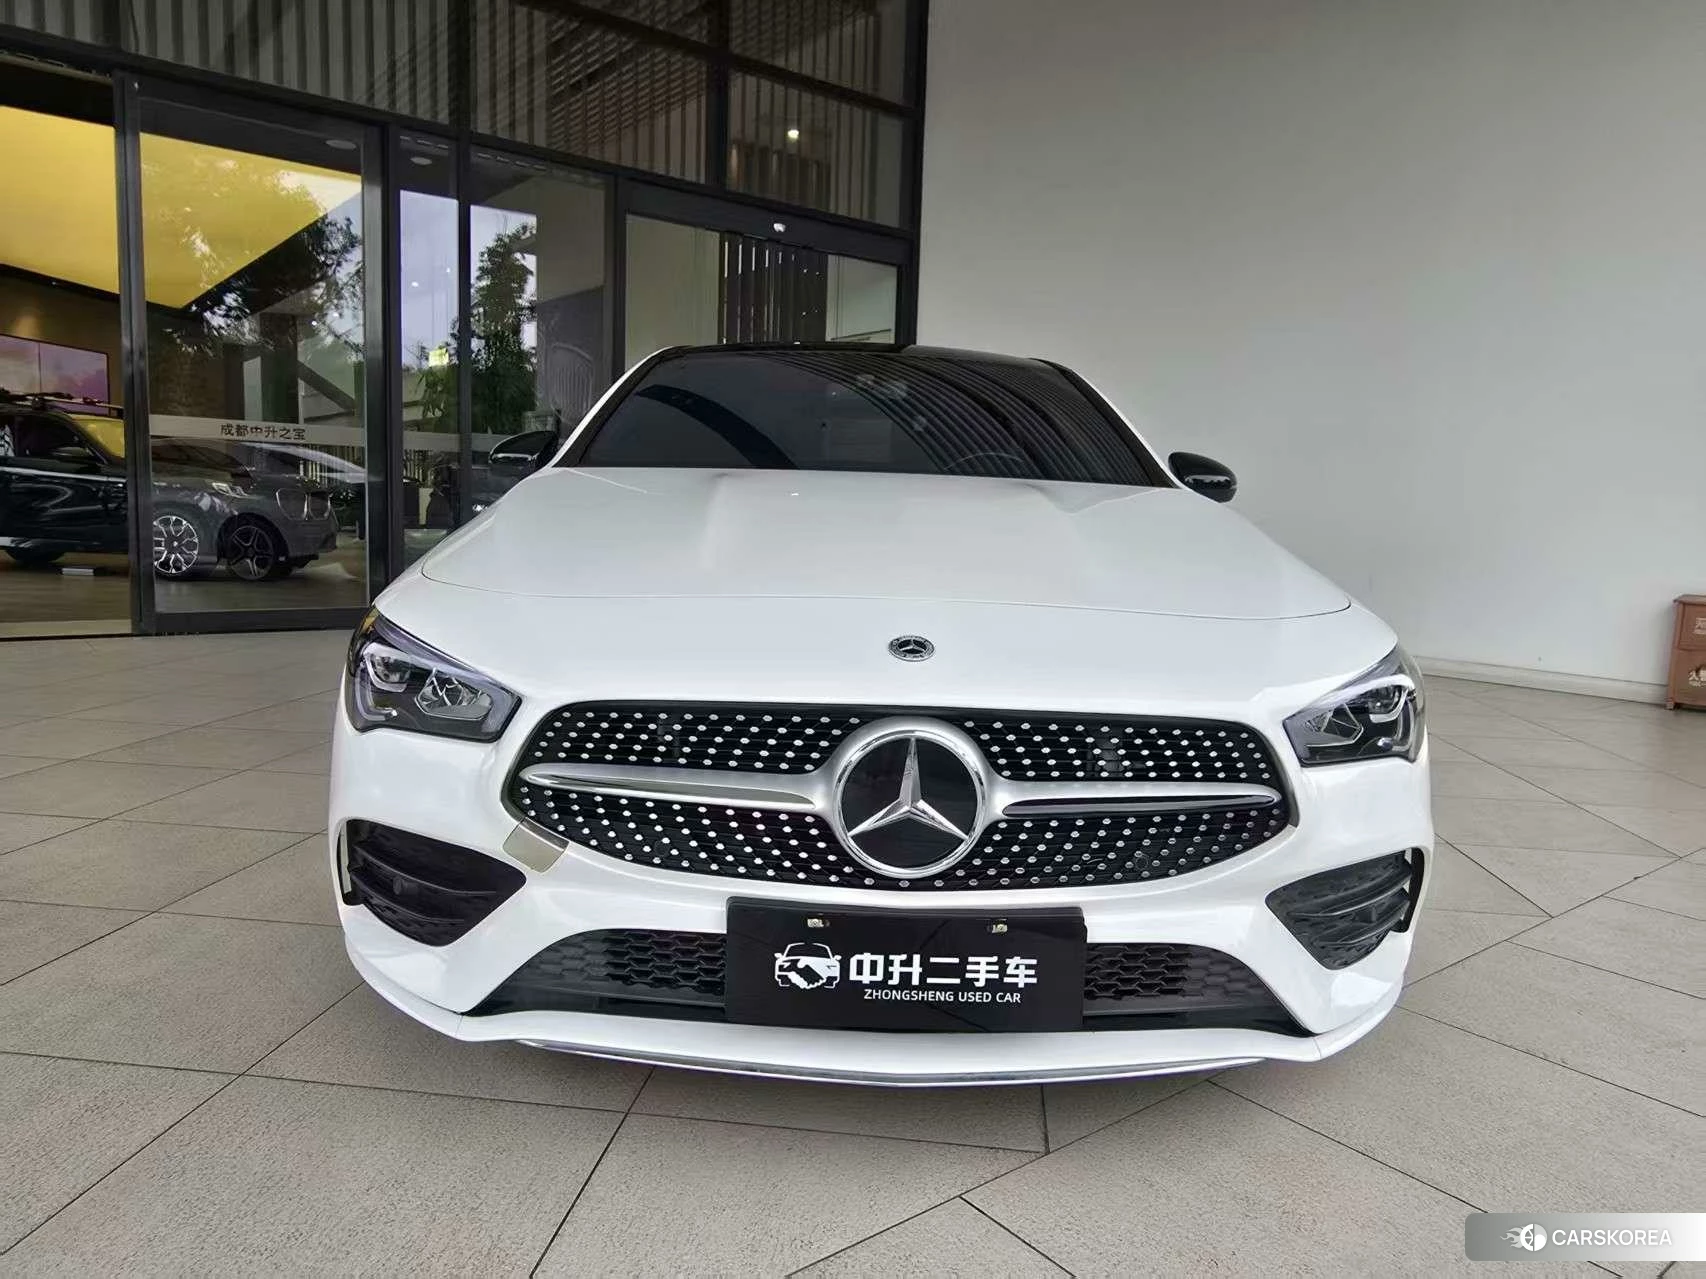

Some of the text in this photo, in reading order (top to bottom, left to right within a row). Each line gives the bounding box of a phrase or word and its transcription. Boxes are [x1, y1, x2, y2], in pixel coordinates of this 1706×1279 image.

[220, 423, 306, 440] 成都中升之宝
[849, 952, 1038, 988] 中升二手车
[863, 988, 1022, 1004] ZHONGSHENG USED CAR
